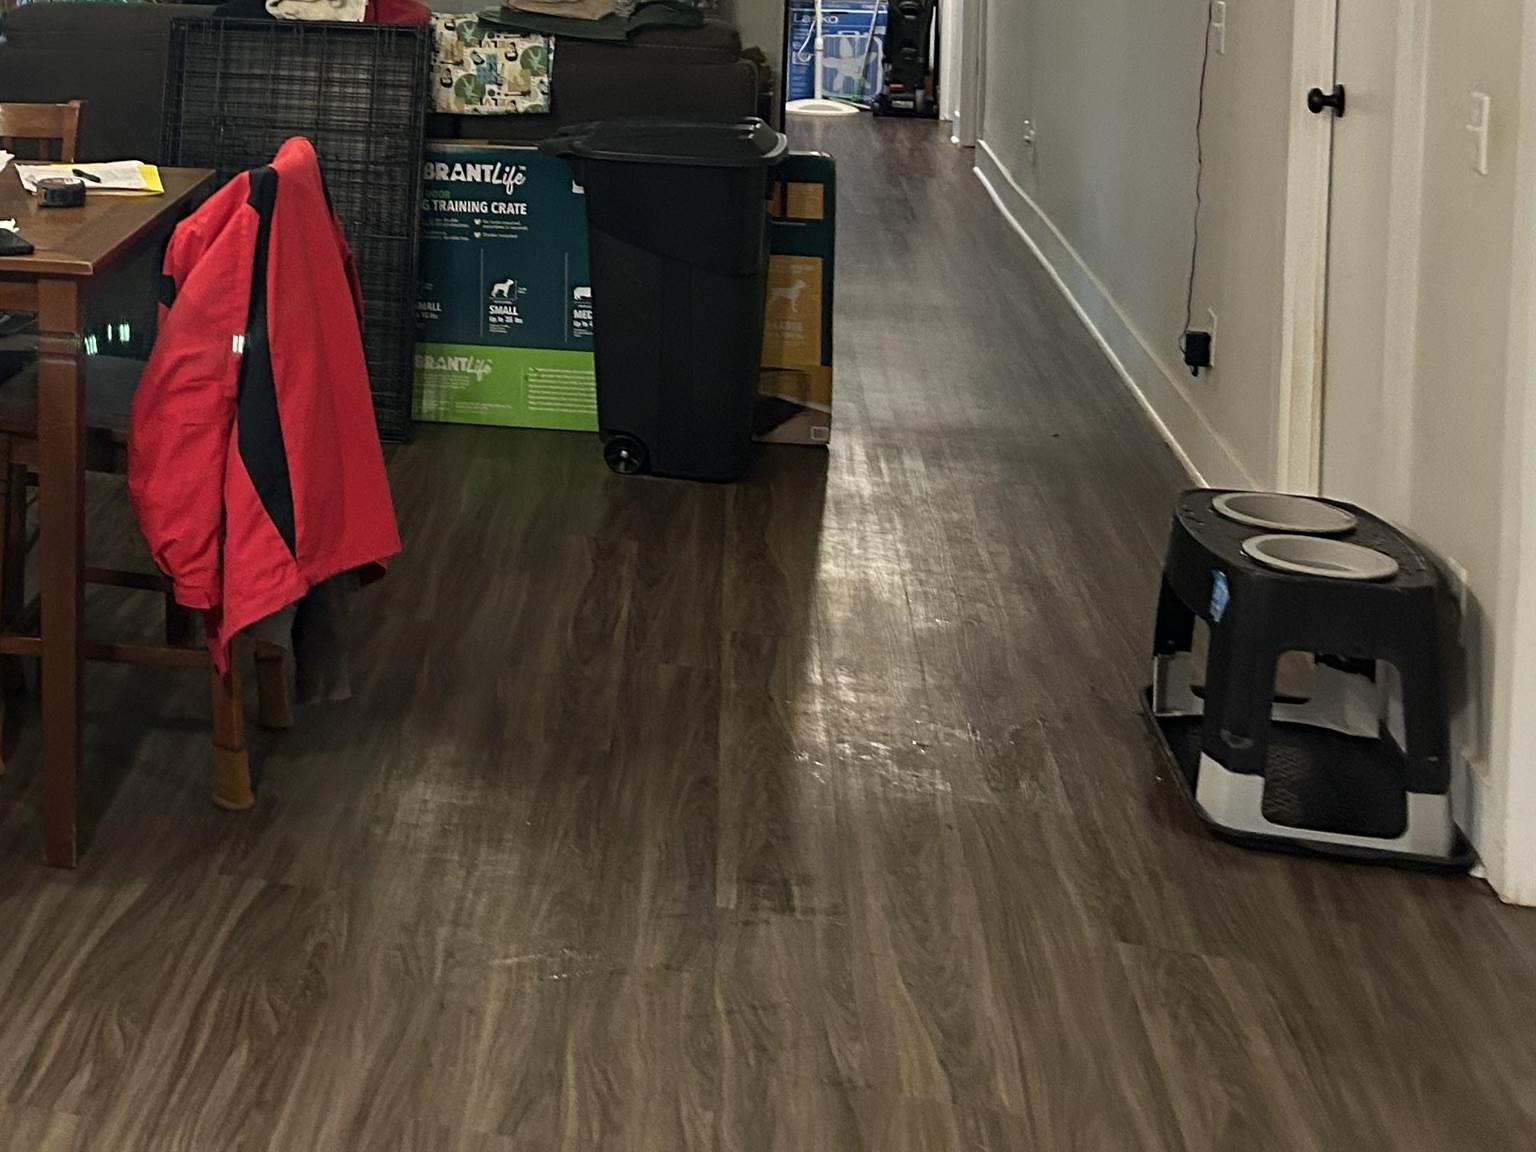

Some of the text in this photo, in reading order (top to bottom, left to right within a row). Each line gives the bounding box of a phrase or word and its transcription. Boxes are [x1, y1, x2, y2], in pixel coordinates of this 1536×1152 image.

[793, 13, 839, 24] Lako
[433, 199, 488, 214] TRAINING
[491, 202, 528, 215] CRATE
[489, 304, 519, 316] SMALL
